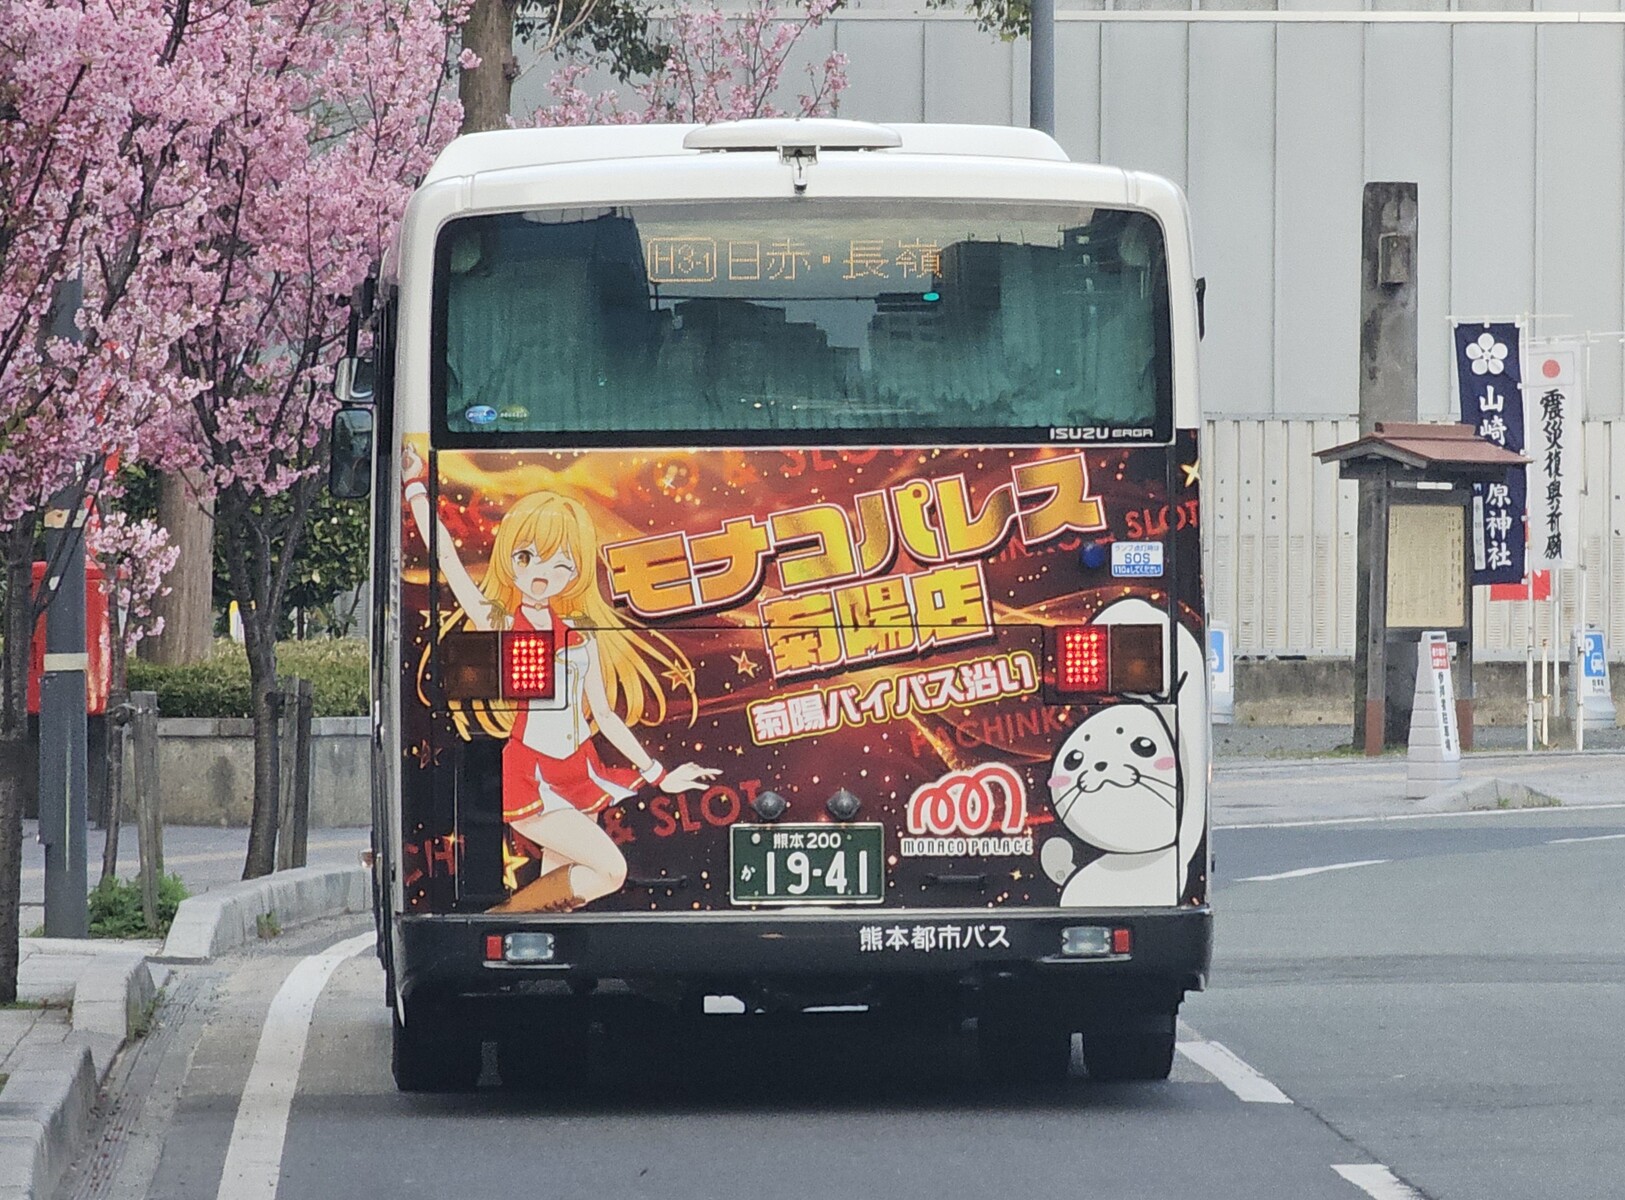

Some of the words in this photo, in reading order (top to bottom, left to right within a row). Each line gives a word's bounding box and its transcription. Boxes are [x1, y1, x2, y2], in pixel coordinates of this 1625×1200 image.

[1050, 427, 1109, 440] ISUZU
[1112, 428, 1154, 438] ERGA
[1479, 385, 1513, 571] 山崎原神社
[604, 454, 1105, 616] モナコパレス
[1125, 552, 1151, 564] SOS
[764, 562, 991, 677] 菊陽店
[750, 654, 1036, 742] 菊陽バイパス沿い
[909, 702, 1086, 757] PACHINK
[902, 839, 965, 855] MONACO
[969, 839, 1030, 854] PALACE
[740, 865, 756, 882] か
[766, 850, 868, 895] 19-41
[859, 924, 1010, 952] 熊本都市バス
